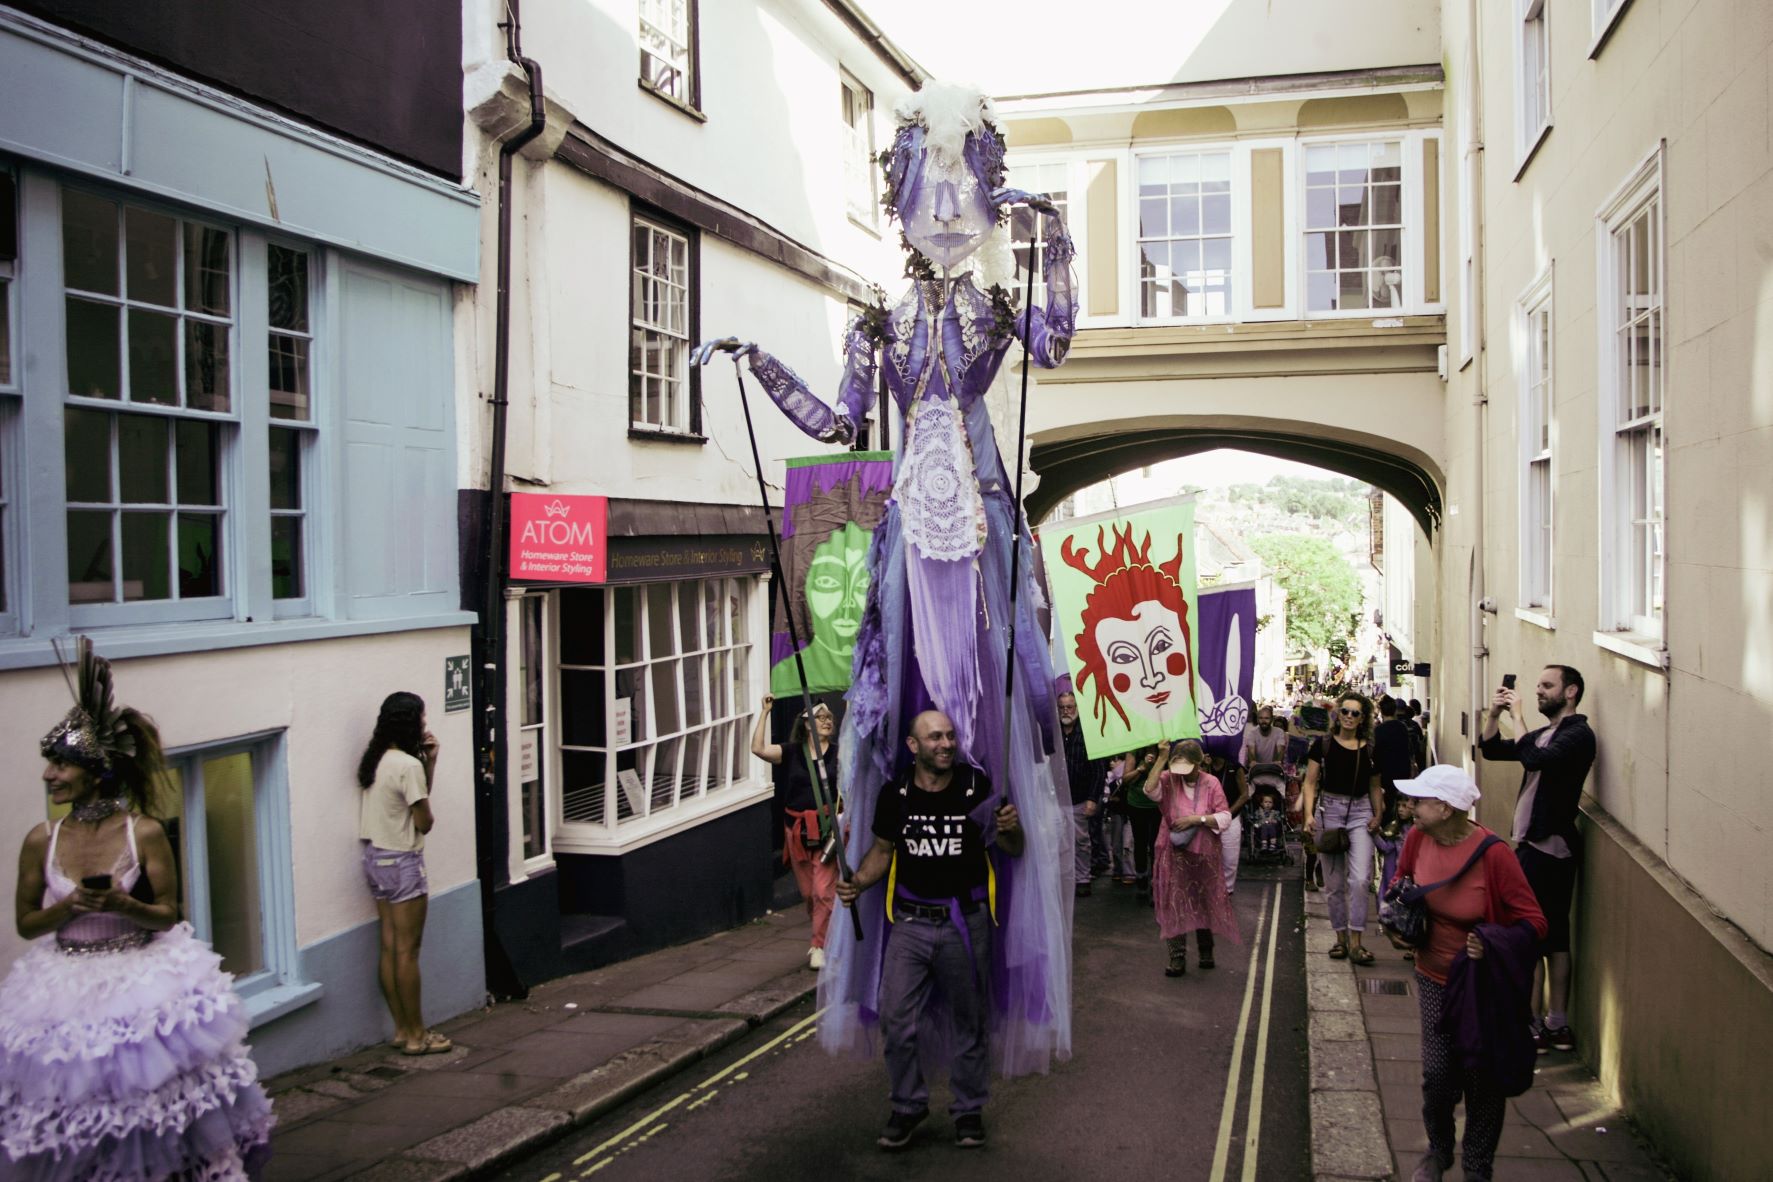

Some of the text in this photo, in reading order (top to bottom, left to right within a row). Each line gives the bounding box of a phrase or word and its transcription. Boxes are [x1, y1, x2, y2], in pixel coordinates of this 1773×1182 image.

[521, 520, 593, 545] ATOM
[521, 550, 593, 562] Homeware Store
[611, 552, 659, 568] Homeware
[661, 550, 682, 565] Store
[691, 549, 716, 564] Interior
[719, 547, 743, 566] Styling
[521, 561, 592, 576] & Interior Styling
[905, 838, 962, 857] DAVE
